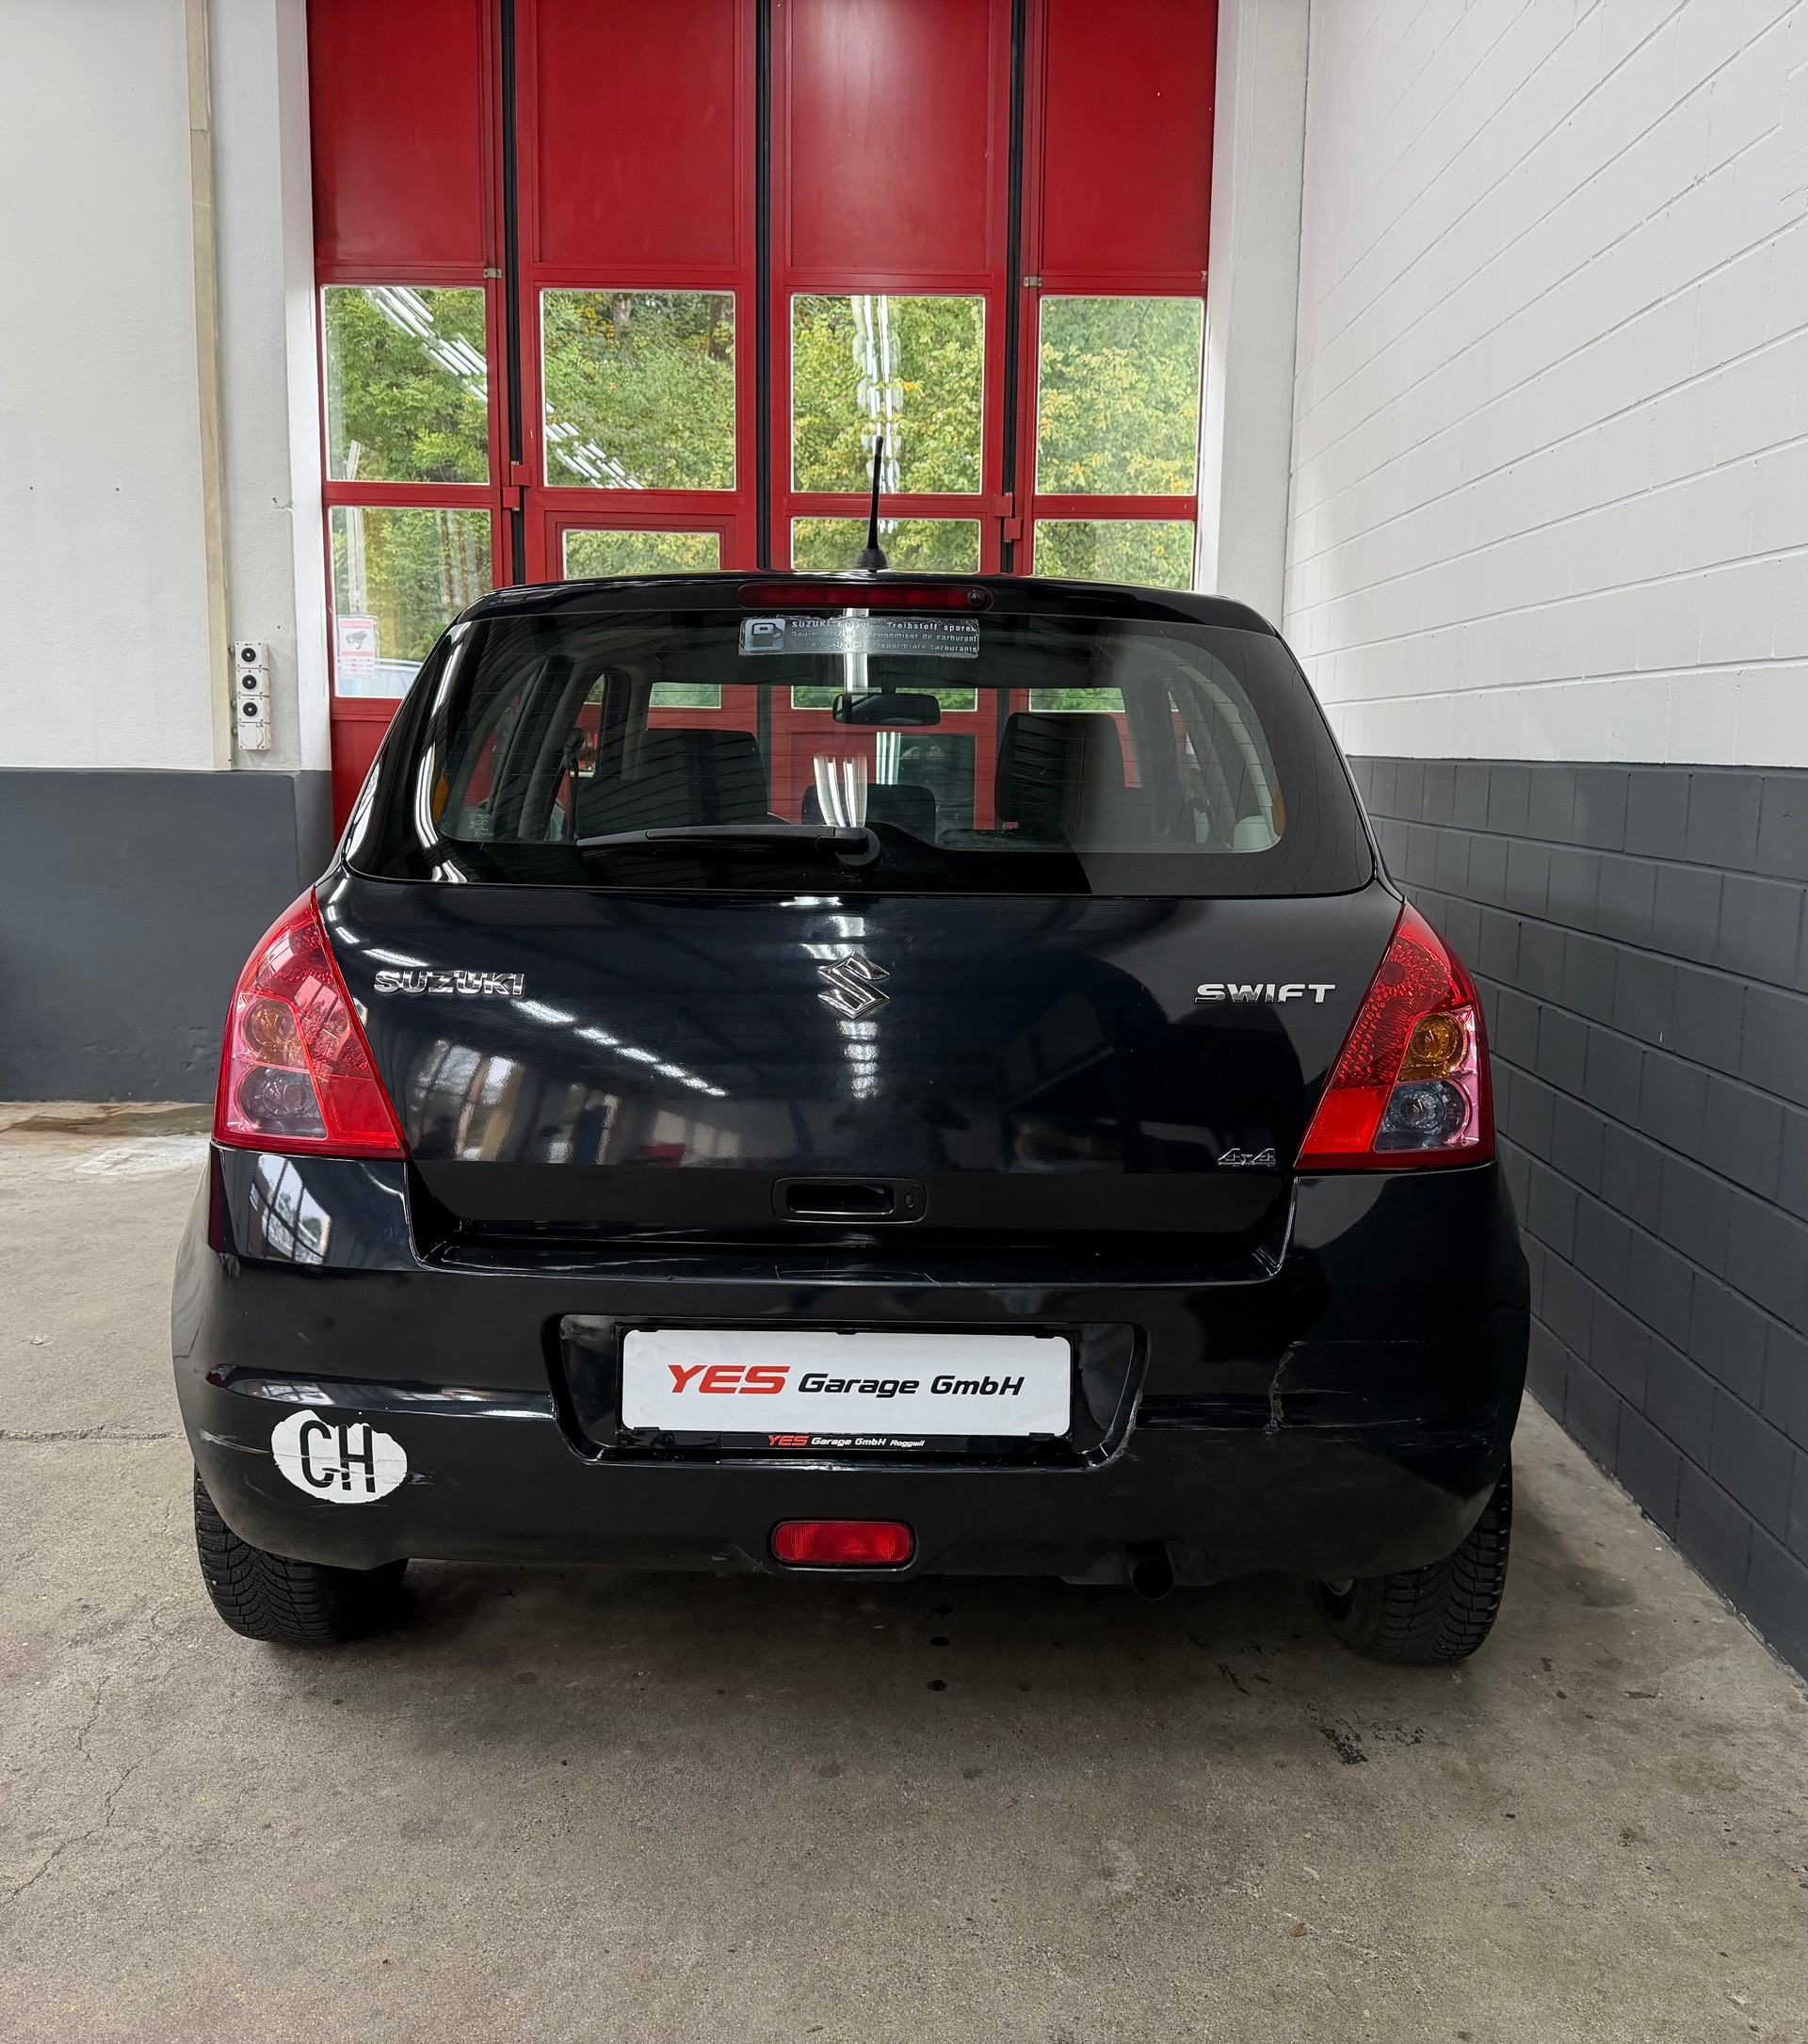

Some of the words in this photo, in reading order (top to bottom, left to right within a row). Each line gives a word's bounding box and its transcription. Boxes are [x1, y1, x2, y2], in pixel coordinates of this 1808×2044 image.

[792, 620, 830, 628] SUZUKI
[887, 621, 938, 630] Treibstoff
[936, 633, 977, 642] carburant
[373, 970, 525, 996] SUZUKI
[1194, 983, 1336, 1004] SWIFT
[1218, 1148, 1276, 1167] 4x4
[667, 1364, 792, 1394] YES
[798, 1373, 920, 1398] Garage
[930, 1376, 1025, 1396] GmbH
[767, 1435, 810, 1446] YES
[811, 1437, 852, 1447] Garage
[855, 1438, 887, 1446] GmbH
[299, 1419, 376, 1493] CH
